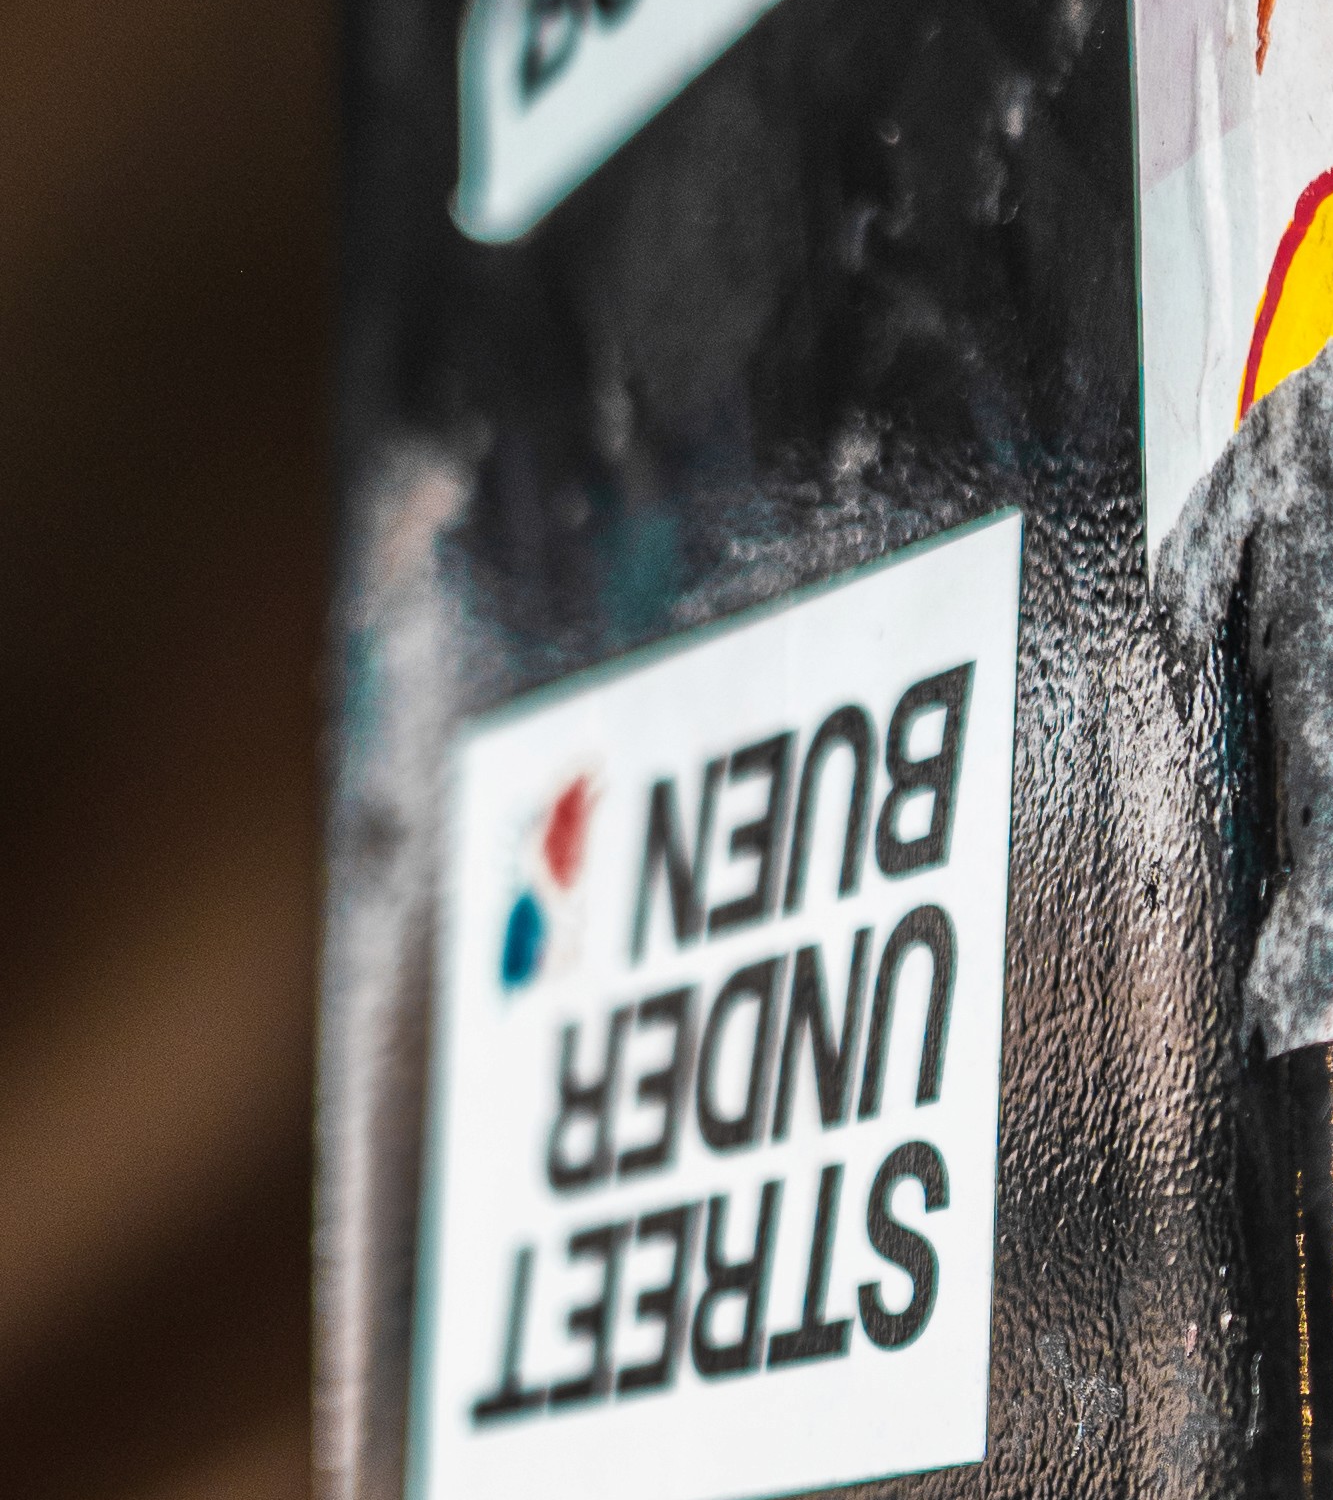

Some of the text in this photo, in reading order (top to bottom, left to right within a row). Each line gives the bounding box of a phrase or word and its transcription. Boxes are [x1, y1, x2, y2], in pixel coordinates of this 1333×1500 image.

[630, 659, 978, 968] BUEN
[544, 904, 958, 1203] UNDER
[472, 1140, 951, 1430] STREET
